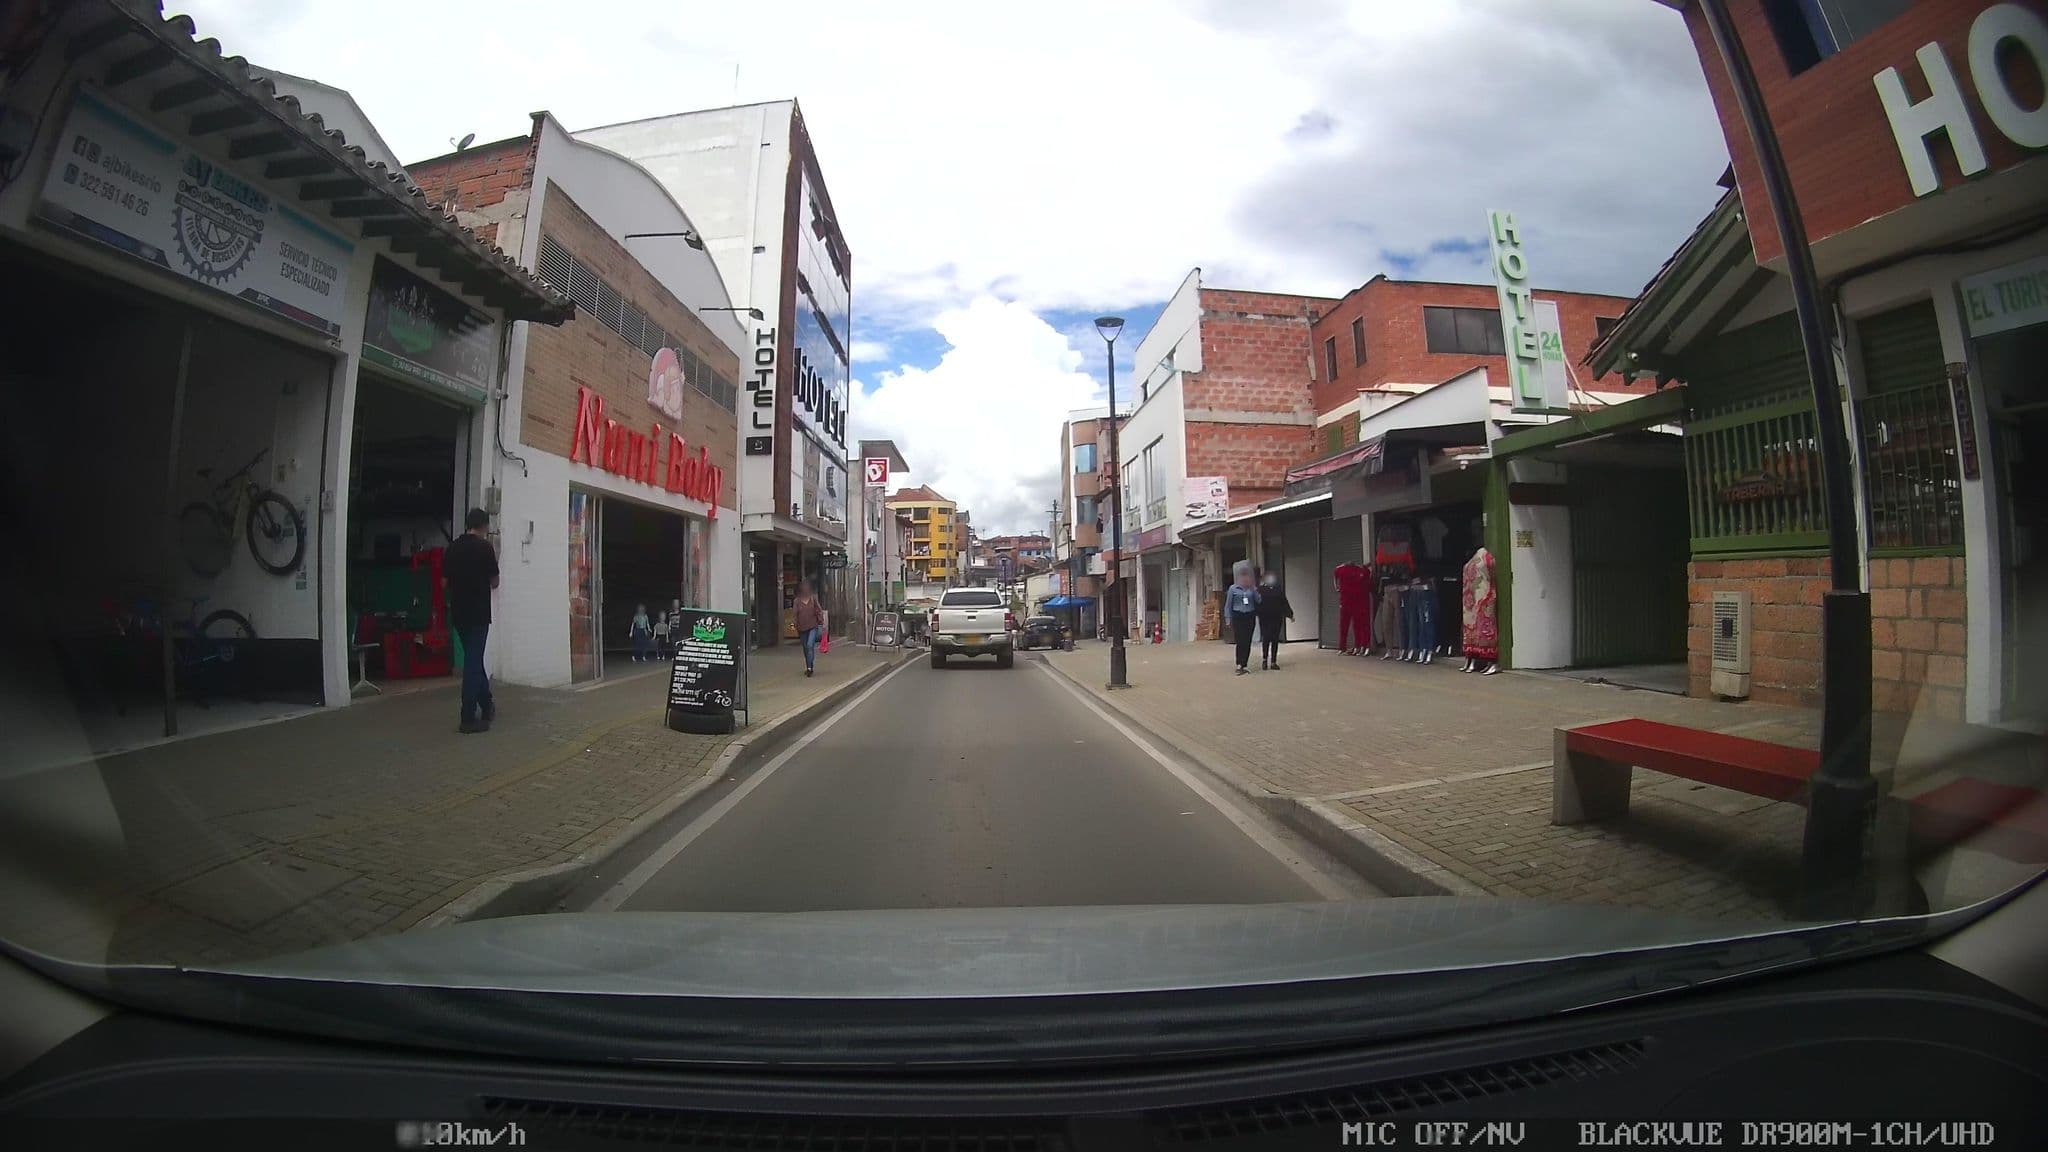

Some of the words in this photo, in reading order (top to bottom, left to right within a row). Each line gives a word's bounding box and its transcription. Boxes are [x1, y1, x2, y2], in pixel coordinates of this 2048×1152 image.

[80, 172, 101, 192] 322
[101, 182, 121, 203] 591
[122, 192, 135, 210] 46
[136, 198, 149, 216] 26
[279, 241, 310, 268] SERVICIO
[280, 261, 330, 296] ESPECIALIZADO
[1492, 211, 1543, 400] HOTEL
[1966, 287, 1994, 321] EL
[1540, 331, 1561, 351] 24
[752, 327, 776, 430] HOTEL
[664, 431, 724, 520] Baby
